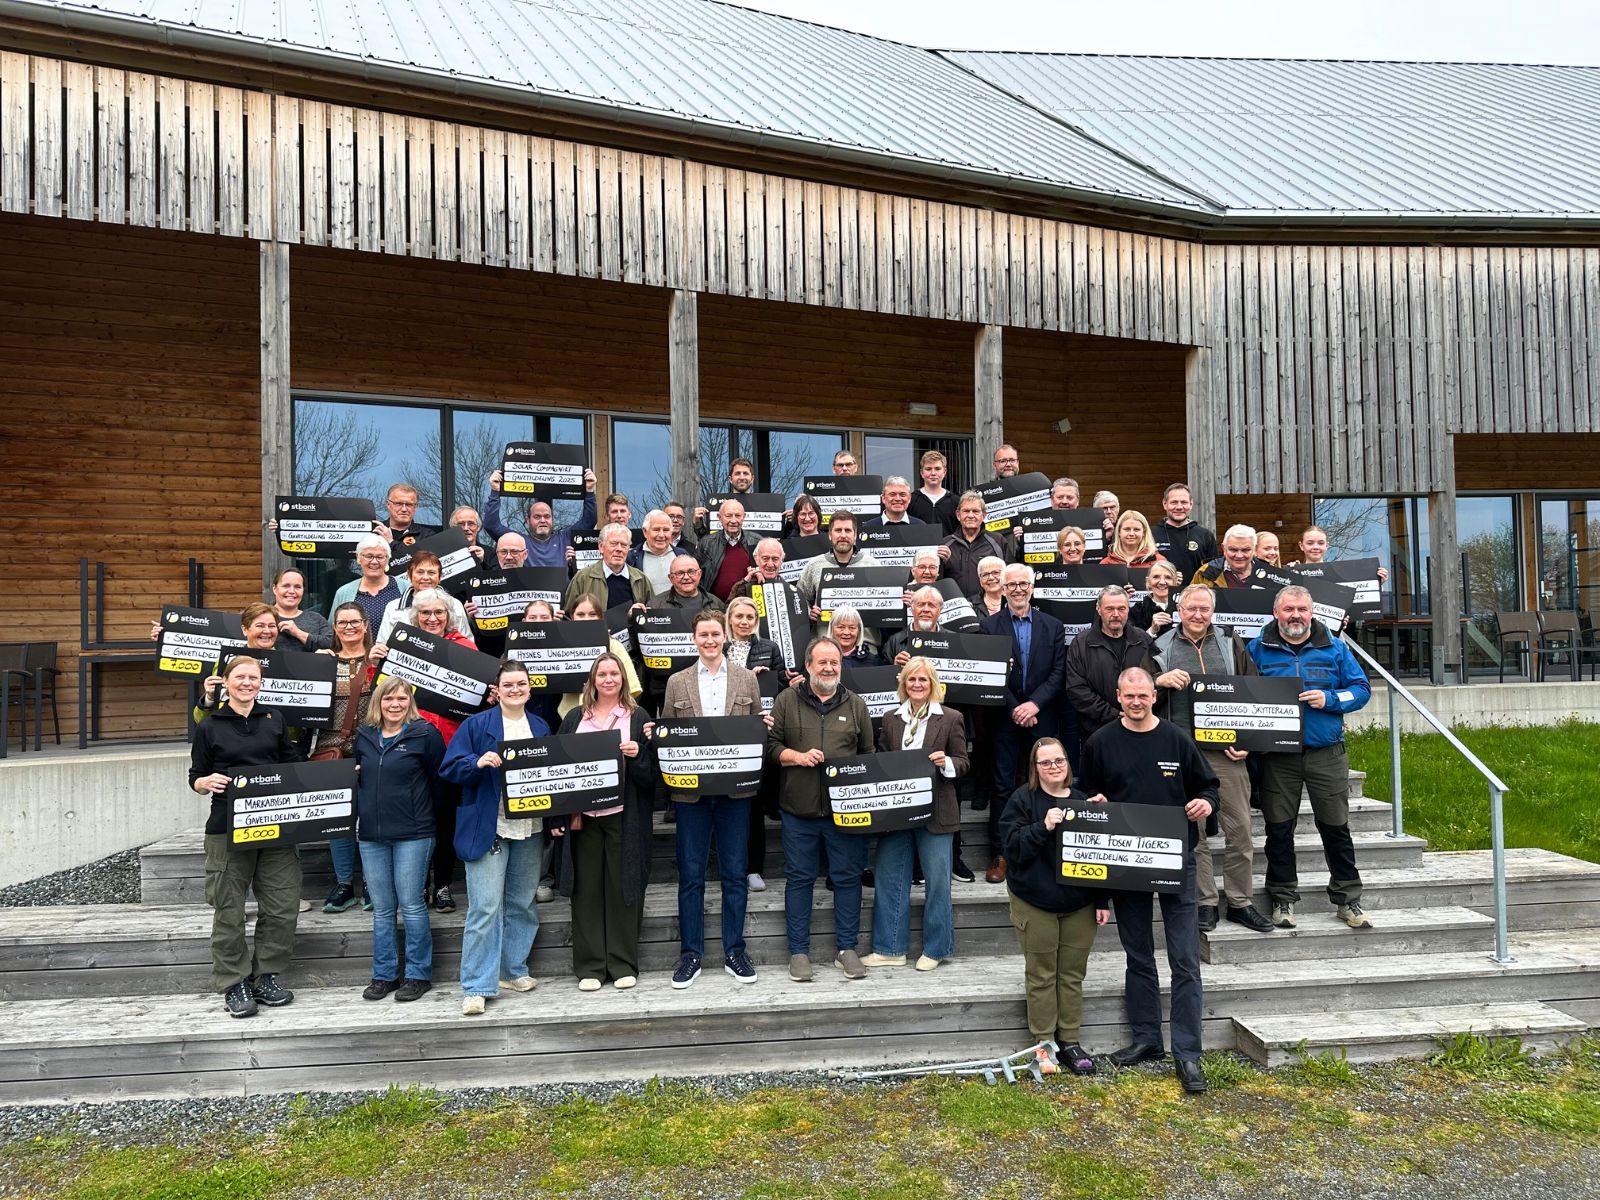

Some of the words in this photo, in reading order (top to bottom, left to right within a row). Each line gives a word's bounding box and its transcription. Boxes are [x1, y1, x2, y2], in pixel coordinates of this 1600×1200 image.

[983, 486, 1003, 495] stbank
[1300, 568, 1324, 576] stbank
[482, 576, 507, 584] stbank
[1266, 573, 1291, 584] stbank
[1042, 588, 1062, 597] RISSA
[481, 595, 504, 606] HYBO
[875, 600, 893, 608] 2025
[181, 615, 210, 626] stbank
[647, 615, 672, 623] stbank
[519, 630, 546, 638] stbank
[173, 633, 224, 646] SKAUGDALEN
[408, 635, 435, 651] stbank
[924, 640, 949, 648] stbank
[517, 650, 542, 660] HYSNES
[395, 651, 432, 673] VANVIKAN
[442, 671, 478, 690] SENTRUM
[564, 662, 582, 671] 2025
[963, 674, 984, 682] 2025
[270, 680, 314, 692] KUNSTLAG
[440, 684, 464, 698] 2025
[1206, 682, 1235, 691] stbank
[288, 696, 308, 704] 2025
[1204, 703, 1248, 714] STADSBYGD
[1251, 704, 1294, 715] SKYTTERLAG
[1257, 720, 1275, 728] 2025
[670, 725, 698, 734] stbank
[518, 745, 548, 756] stbank
[667, 748, 691, 758] RISSA
[694, 747, 740, 757] UNGDOMSLAG
[717, 761, 738, 770] 2025
[839, 763, 867, 774] stbank
[519, 769, 542, 780] INDRE
[547, 766, 569, 777] FOSEN
[574, 764, 599, 774] BRASS
[249, 774, 282, 784] stbank
[581, 777, 605, 788] 2025
[838, 786, 871, 798] STJØRNA
[873, 782, 916, 794] TEATERLAG
[244, 796, 291, 810] MARKABYGDA
[296, 791, 345, 805] VELFORENING
[892, 796, 912, 805] 2025
[305, 808, 326, 818] 2025
[1077, 810, 1109, 820] stbank
[840, 814, 869, 825] 10.000
[242, 829, 276, 840] 5.000
[1073, 833, 1101, 845] INDRE
[1107, 835, 1133, 847] FOSEN
[1136, 836, 1170, 849] TIGERS
[1135, 854, 1154, 864] 2025
[1071, 863, 1104, 876] 7.500
